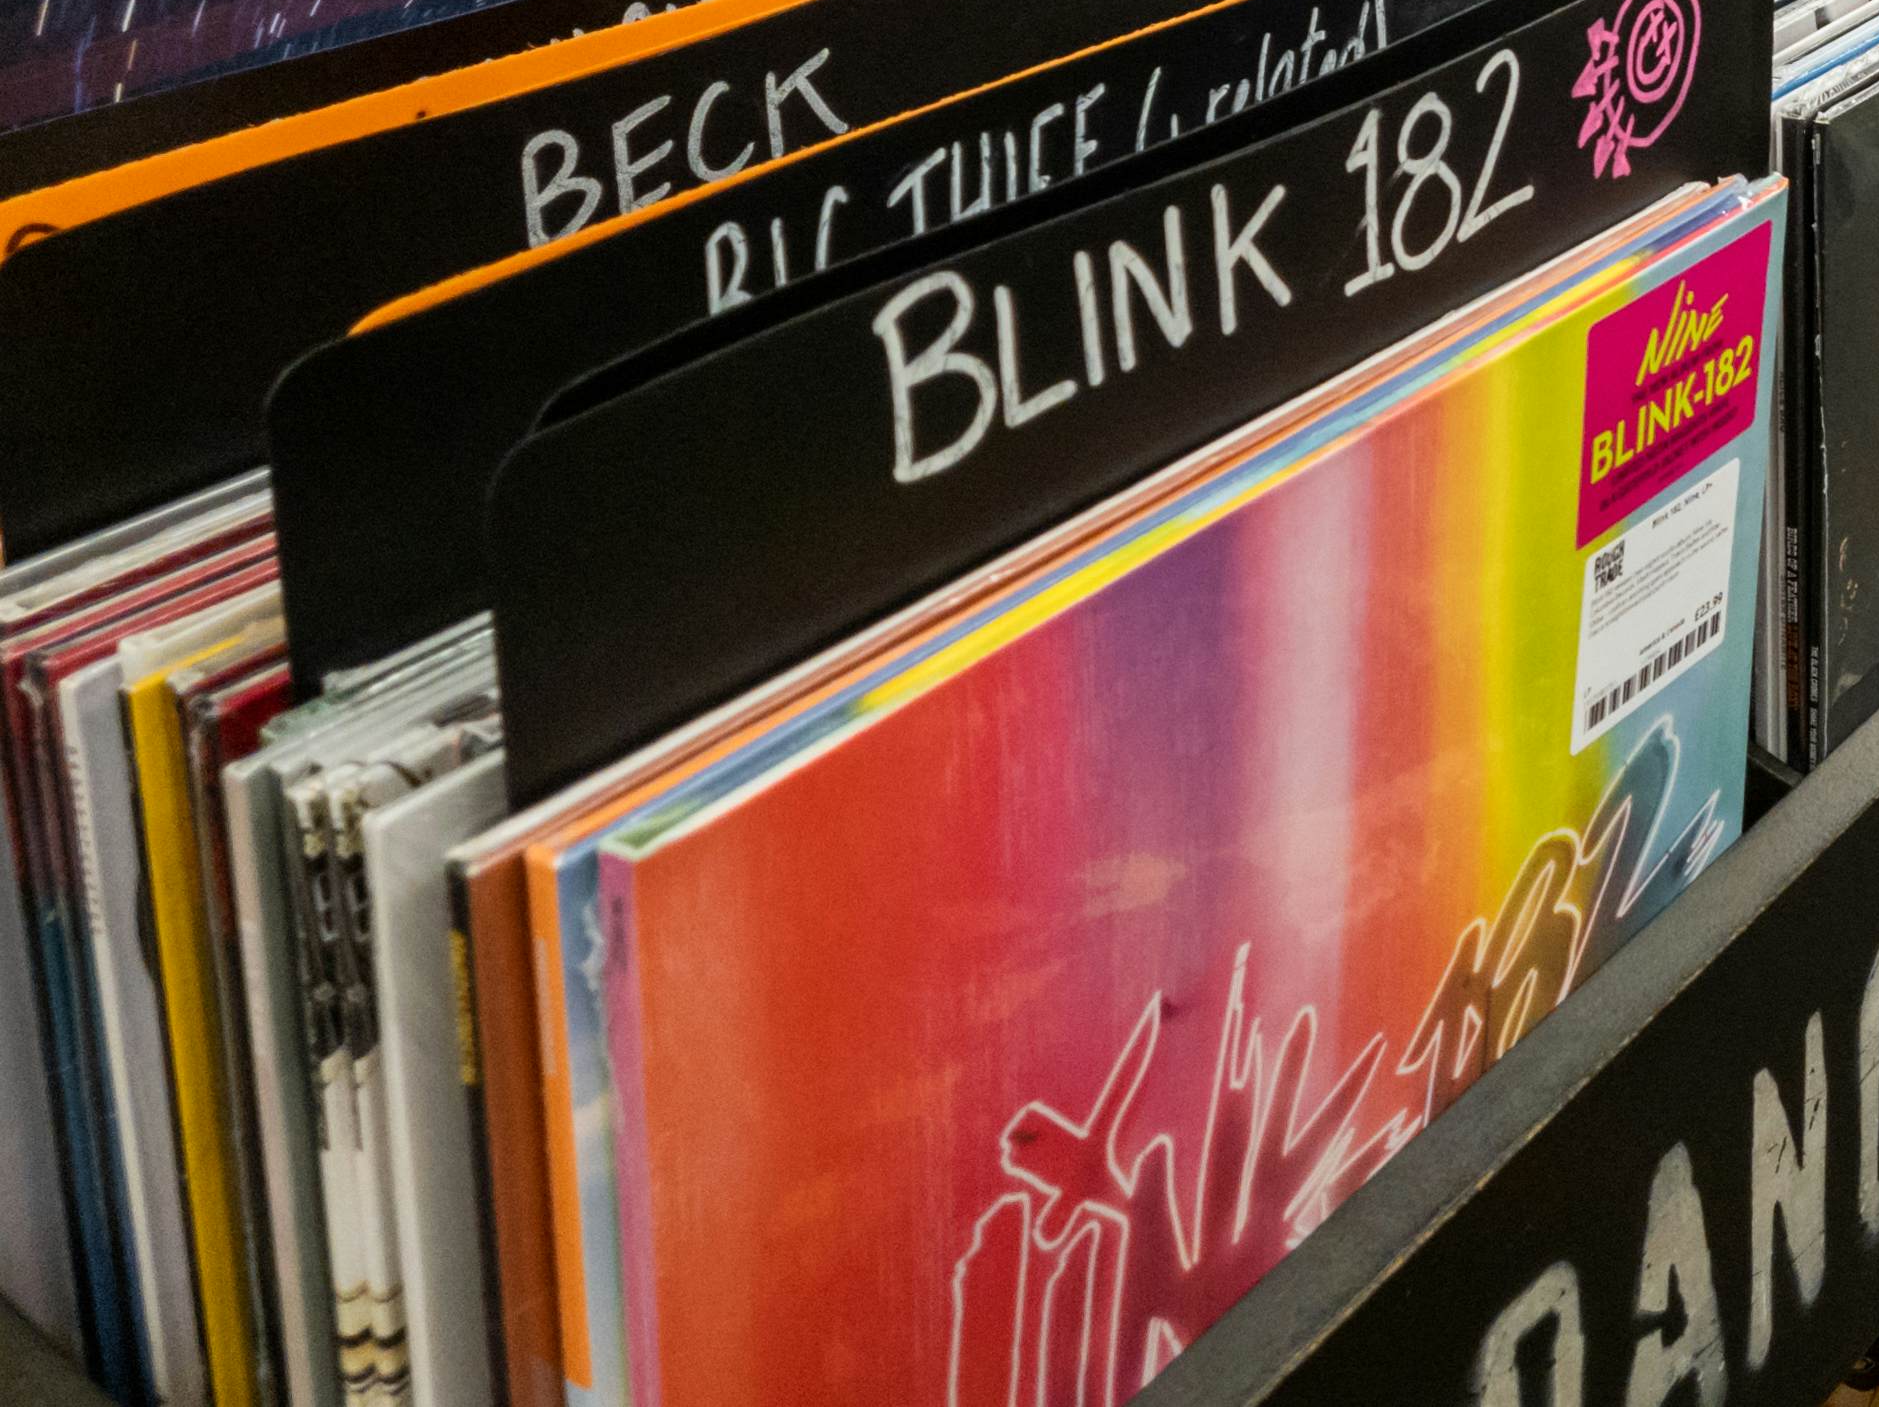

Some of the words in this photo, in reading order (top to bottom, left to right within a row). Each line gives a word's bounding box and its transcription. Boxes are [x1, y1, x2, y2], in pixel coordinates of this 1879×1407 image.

[521, 47, 850, 249] BECK
[873, 184, 1292, 484] BLINK
[1344, 47, 1535, 297] 182
[1590, 335, 1754, 485] BLINK-182
[1594, 559, 1624, 593] TRADE
